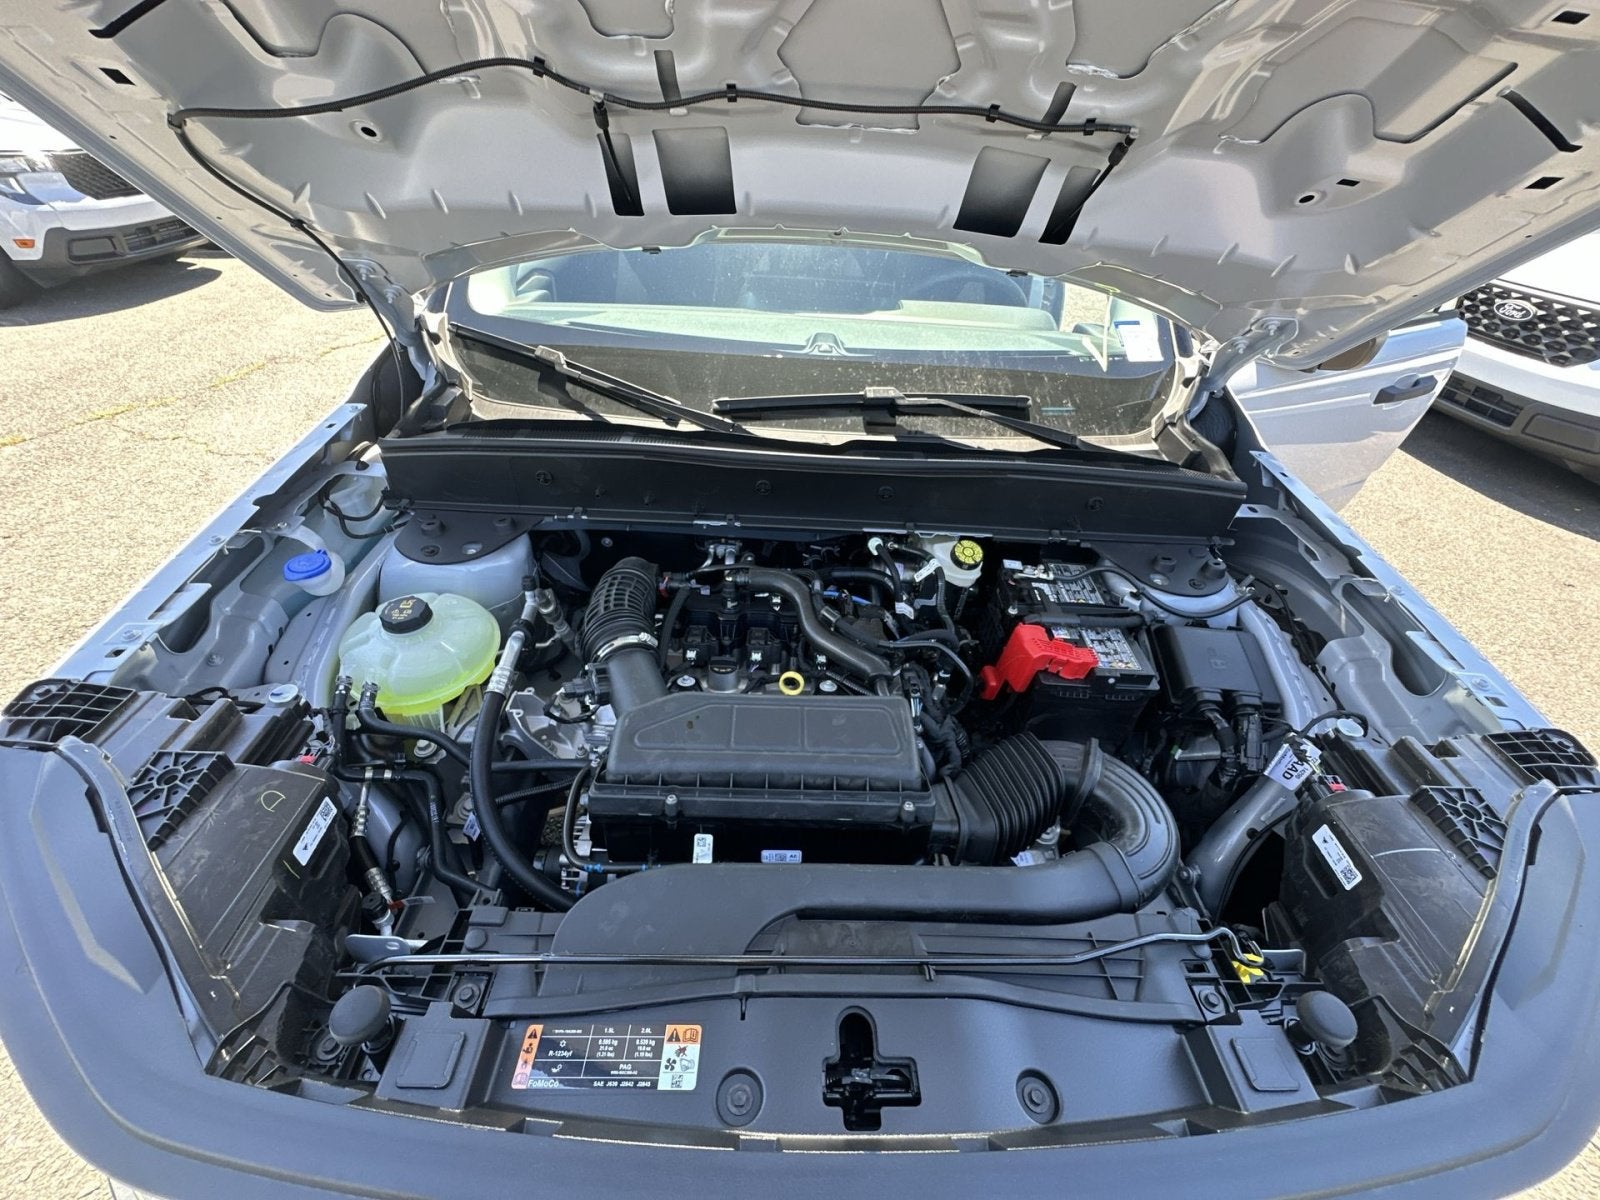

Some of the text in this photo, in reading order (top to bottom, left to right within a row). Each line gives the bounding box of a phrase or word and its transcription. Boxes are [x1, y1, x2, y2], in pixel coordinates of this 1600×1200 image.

[611, 1039, 618, 1047] kg
[649, 1039, 656, 1047] kg
[548, 1050, 573, 1058] R-1234yf
[527, 1079, 559, 1088] FoMoCo
